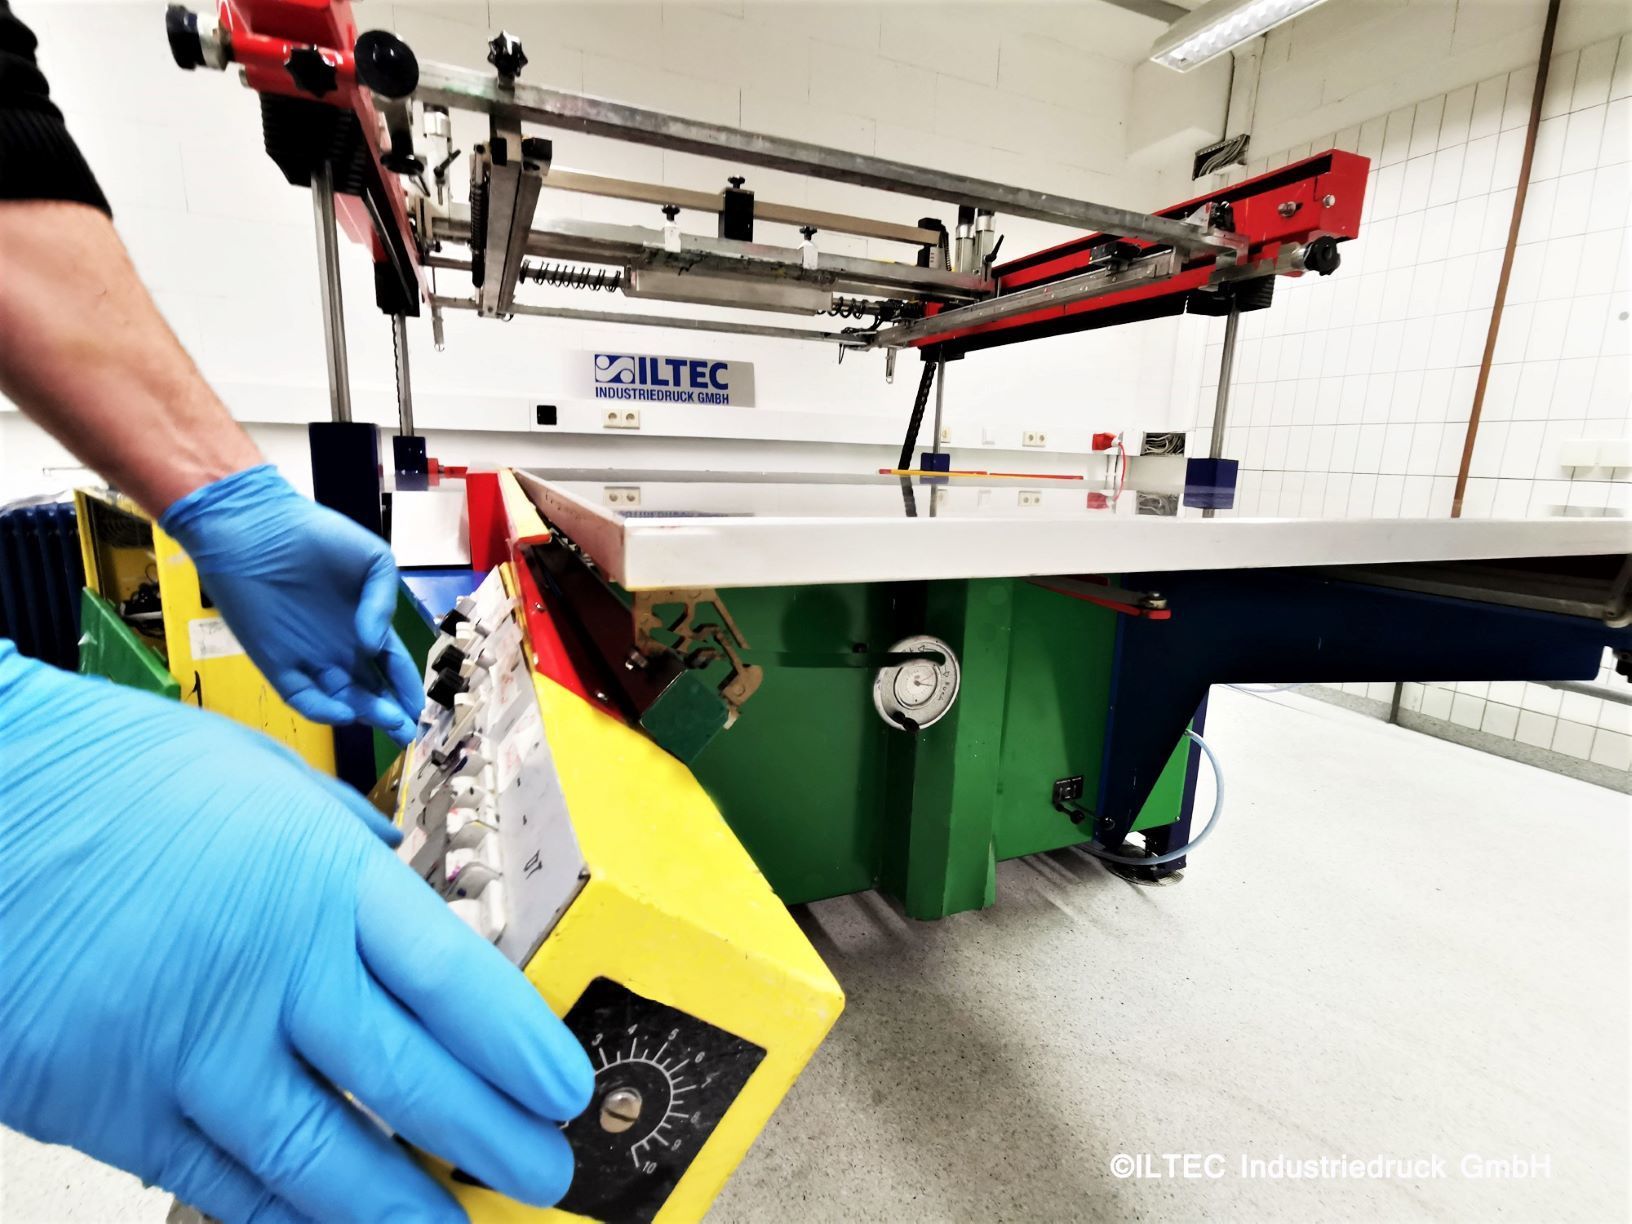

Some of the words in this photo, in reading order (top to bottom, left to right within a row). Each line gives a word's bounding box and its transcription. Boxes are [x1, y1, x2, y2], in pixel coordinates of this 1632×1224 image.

[638, 356, 729, 390] ILTEC
[595, 387, 695, 403] INDUSTRIEDRUCK
[698, 392, 729, 405] GMBH
[642, 1161, 658, 1174] 10
